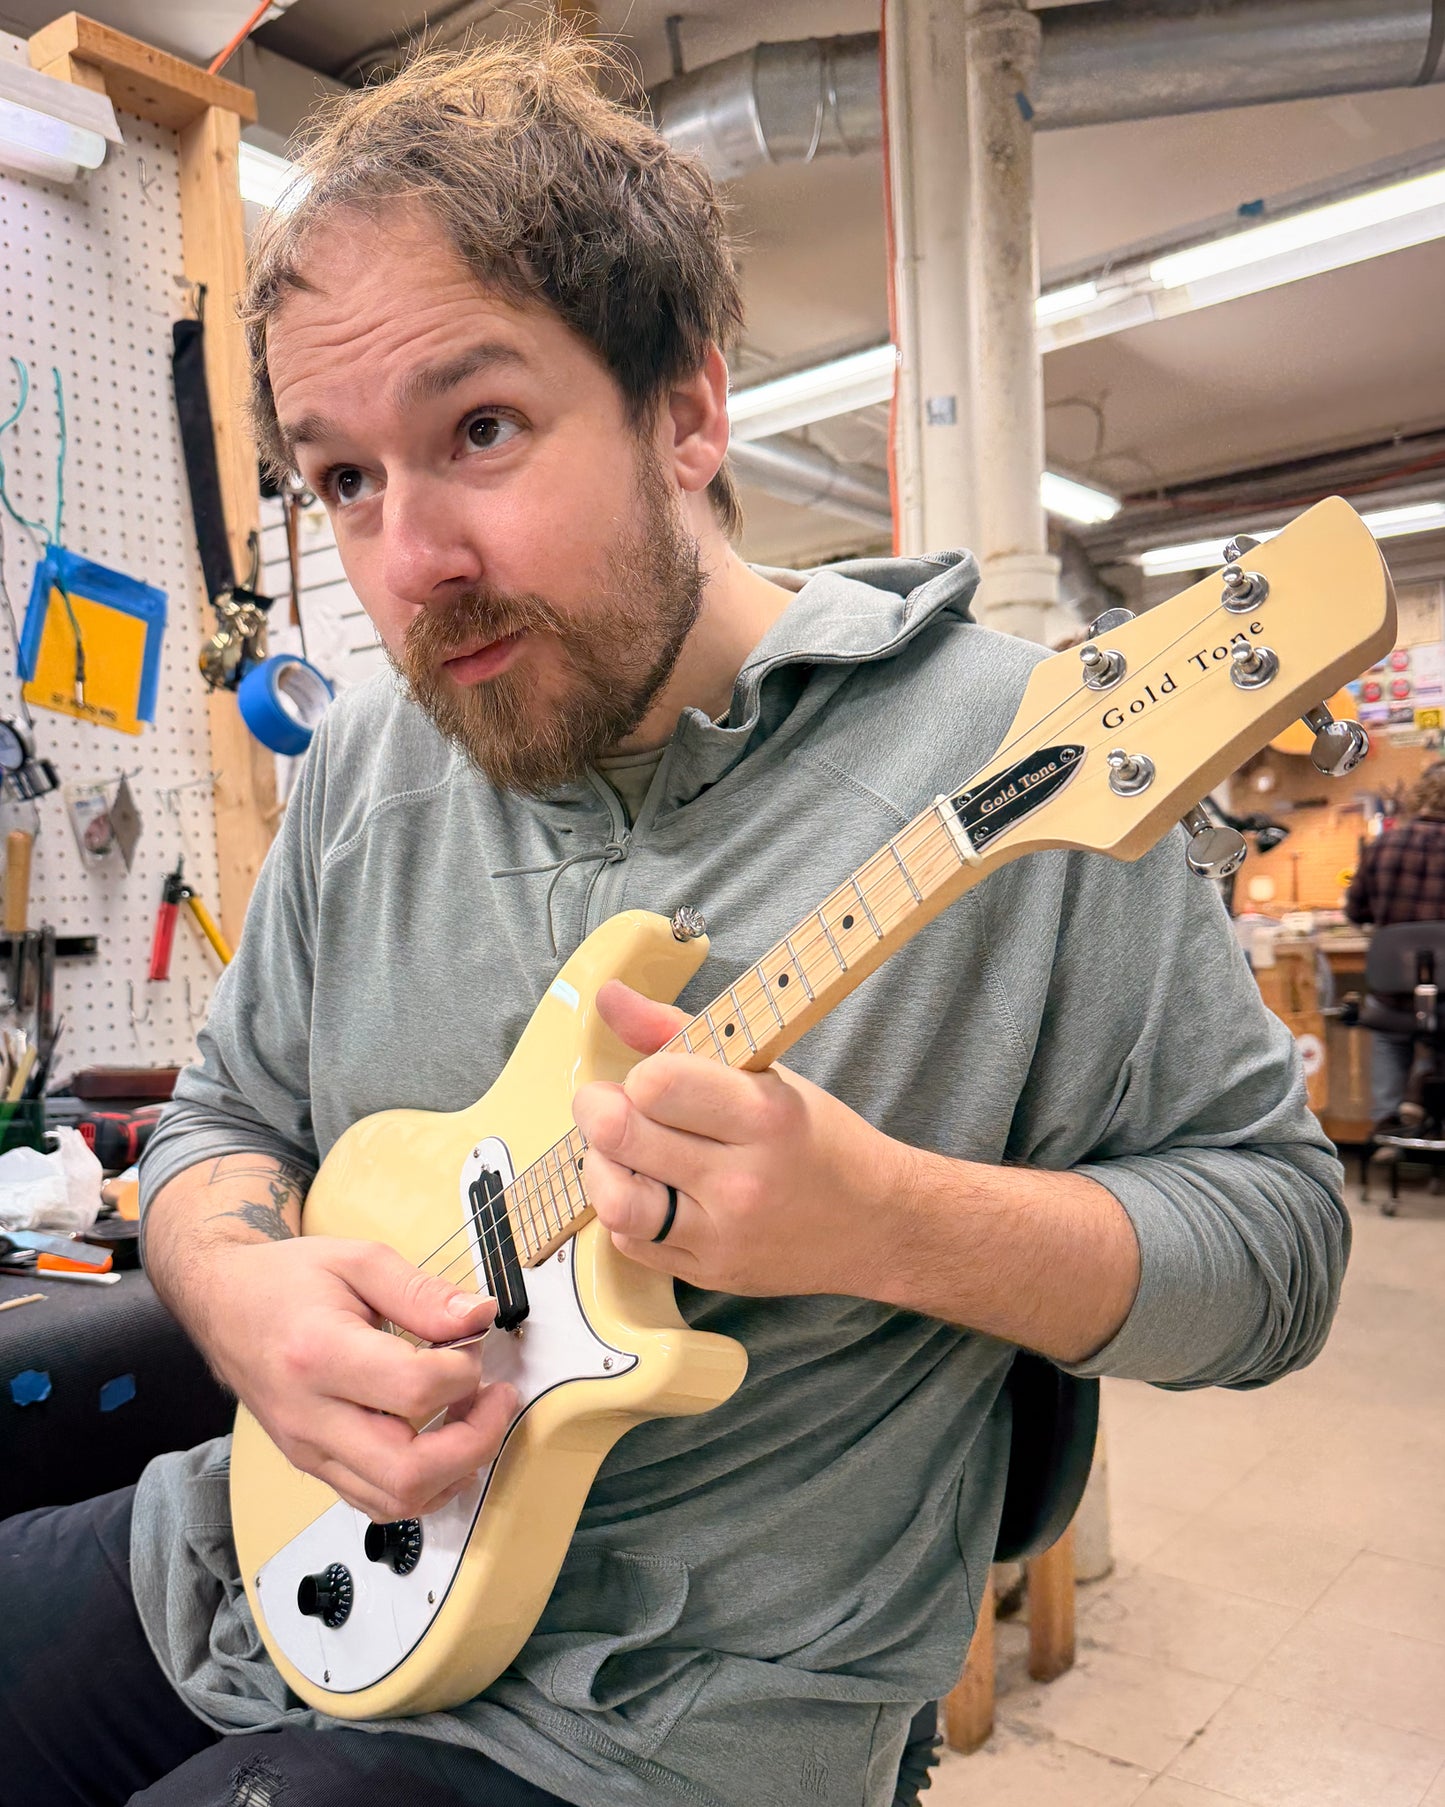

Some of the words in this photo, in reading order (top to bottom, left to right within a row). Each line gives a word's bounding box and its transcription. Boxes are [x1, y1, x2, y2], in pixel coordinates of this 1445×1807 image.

[1102, 672, 1178, 729] Gold
[1188, 621, 1264, 672] Tone
[980, 783, 1018, 814] Gold
[1018, 761, 1057, 789] Tone
